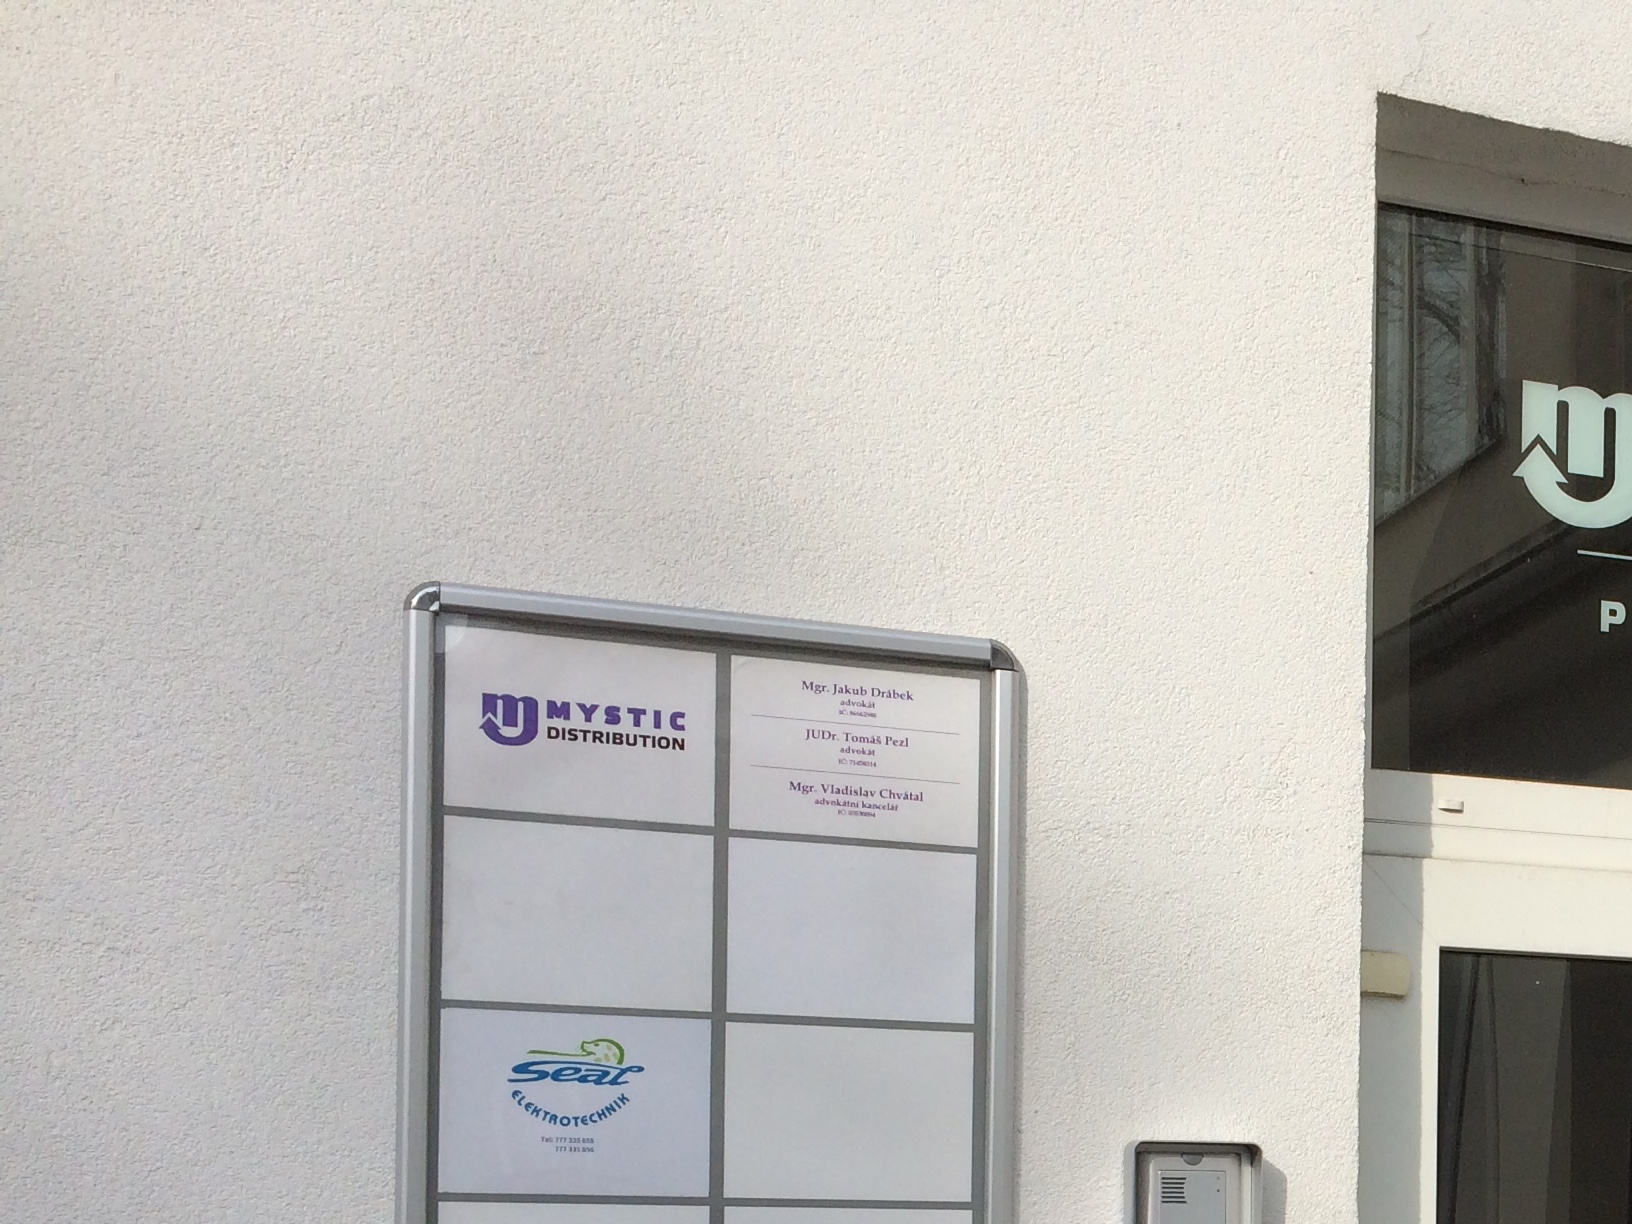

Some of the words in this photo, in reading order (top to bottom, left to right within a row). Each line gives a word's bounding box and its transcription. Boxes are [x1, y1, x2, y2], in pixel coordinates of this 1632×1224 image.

[801, 680, 830, 694] Mgr.
[832, 683, 868, 696] Jakub
[871, 687, 914, 701] Drábek
[840, 699, 876, 708] advokát
[546, 700, 687, 732] MYSTIC
[547, 726, 686, 751] DISTRIBUTION
[805, 728, 840, 741] JUDr.
[843, 732, 882, 745] Tomáš
[885, 736, 909, 747] Pezl
[840, 746, 876, 756] advokát
[789, 781, 818, 794] Mgr.
[820, 783, 876, 798] Vladislav
[879, 788, 924, 802] Chvátal
[814, 797, 859, 808] advokátní
[861, 801, 899, 812] kancelář
[511, 1089, 631, 1127] ELEKTROTECHNIK
